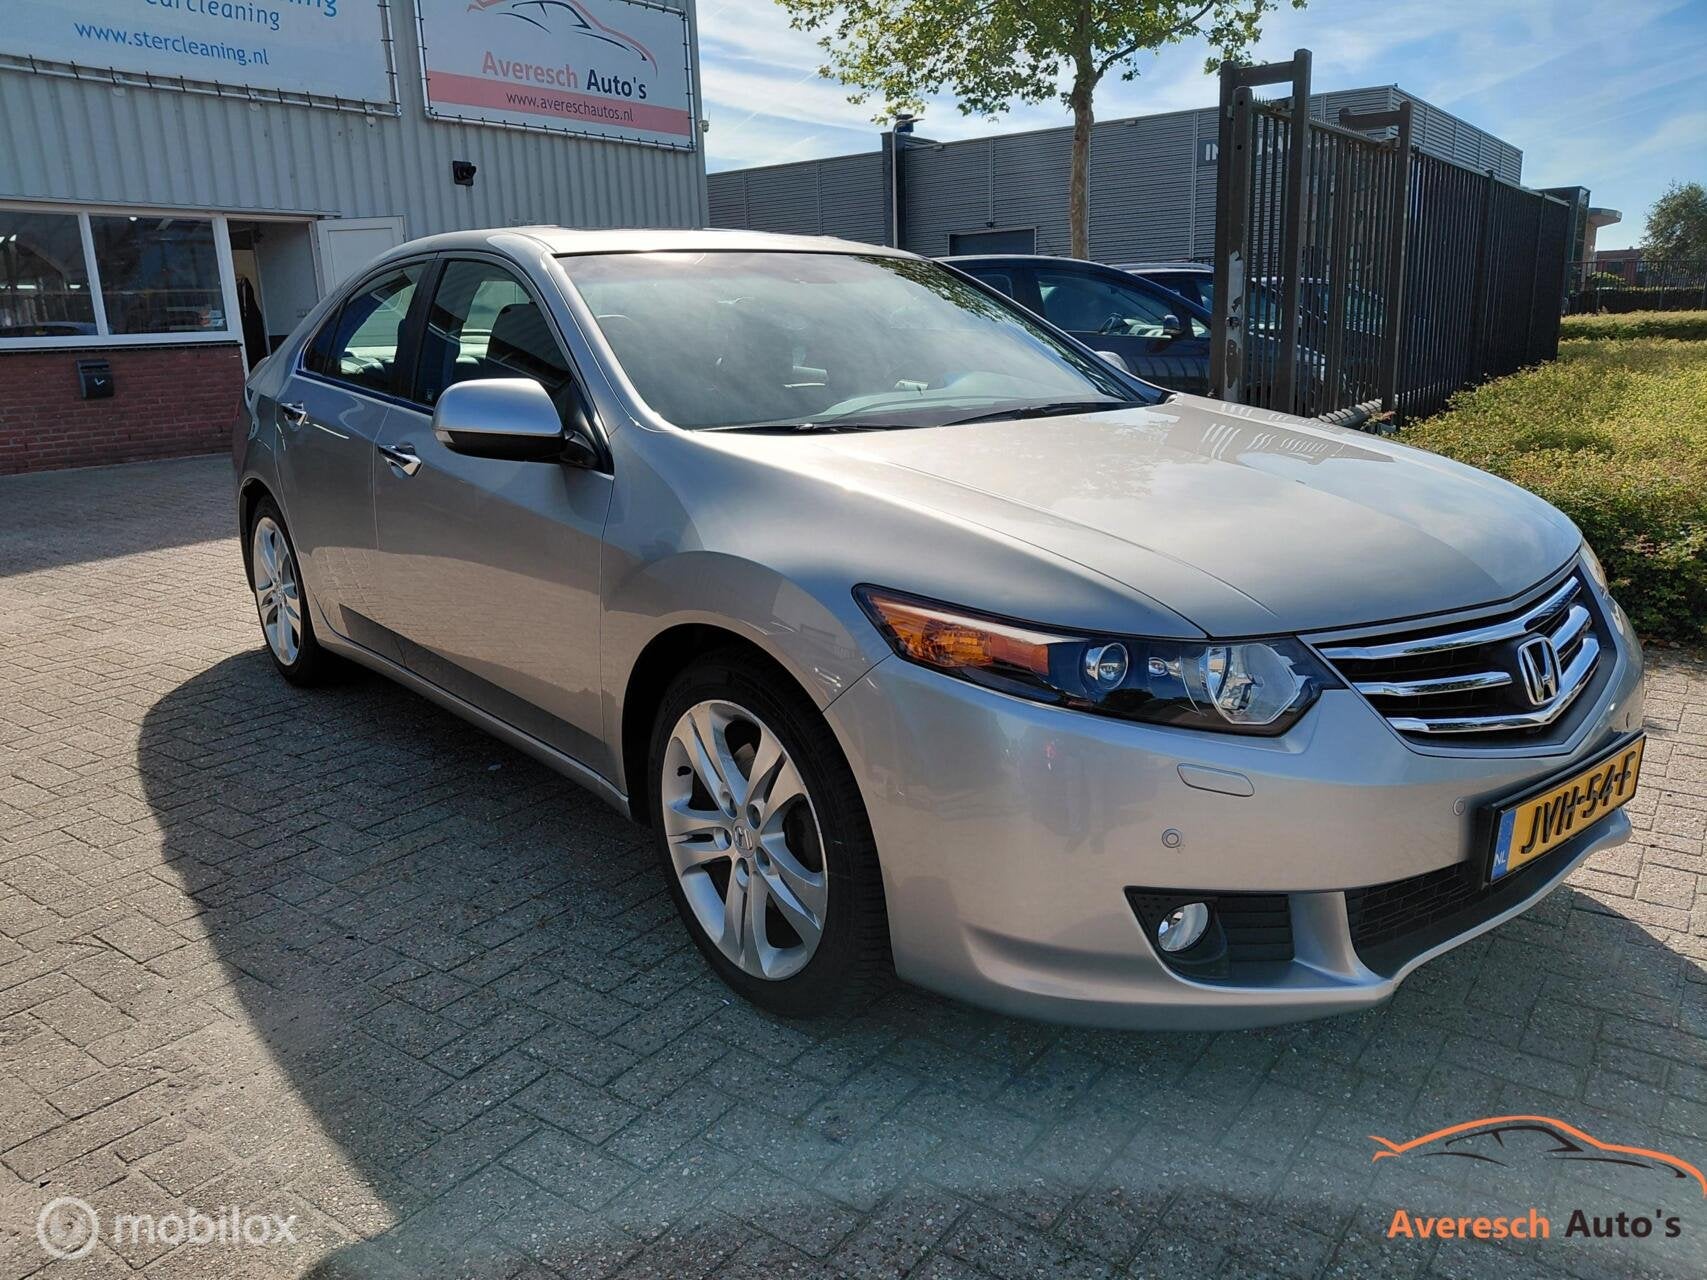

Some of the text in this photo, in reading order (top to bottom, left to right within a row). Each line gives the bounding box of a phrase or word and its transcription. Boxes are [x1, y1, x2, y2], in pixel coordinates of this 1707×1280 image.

[146, 0, 280, 31] rcleaning
[73, 22, 270, 66] www.stercleaning.nl
[482, 51, 647, 100] Averesch Auto's
[506, 92, 634, 122] www.avereschautos.nl
[1520, 751, 1637, 854] JVH-54-F
[1495, 850, 1506, 866] NL
